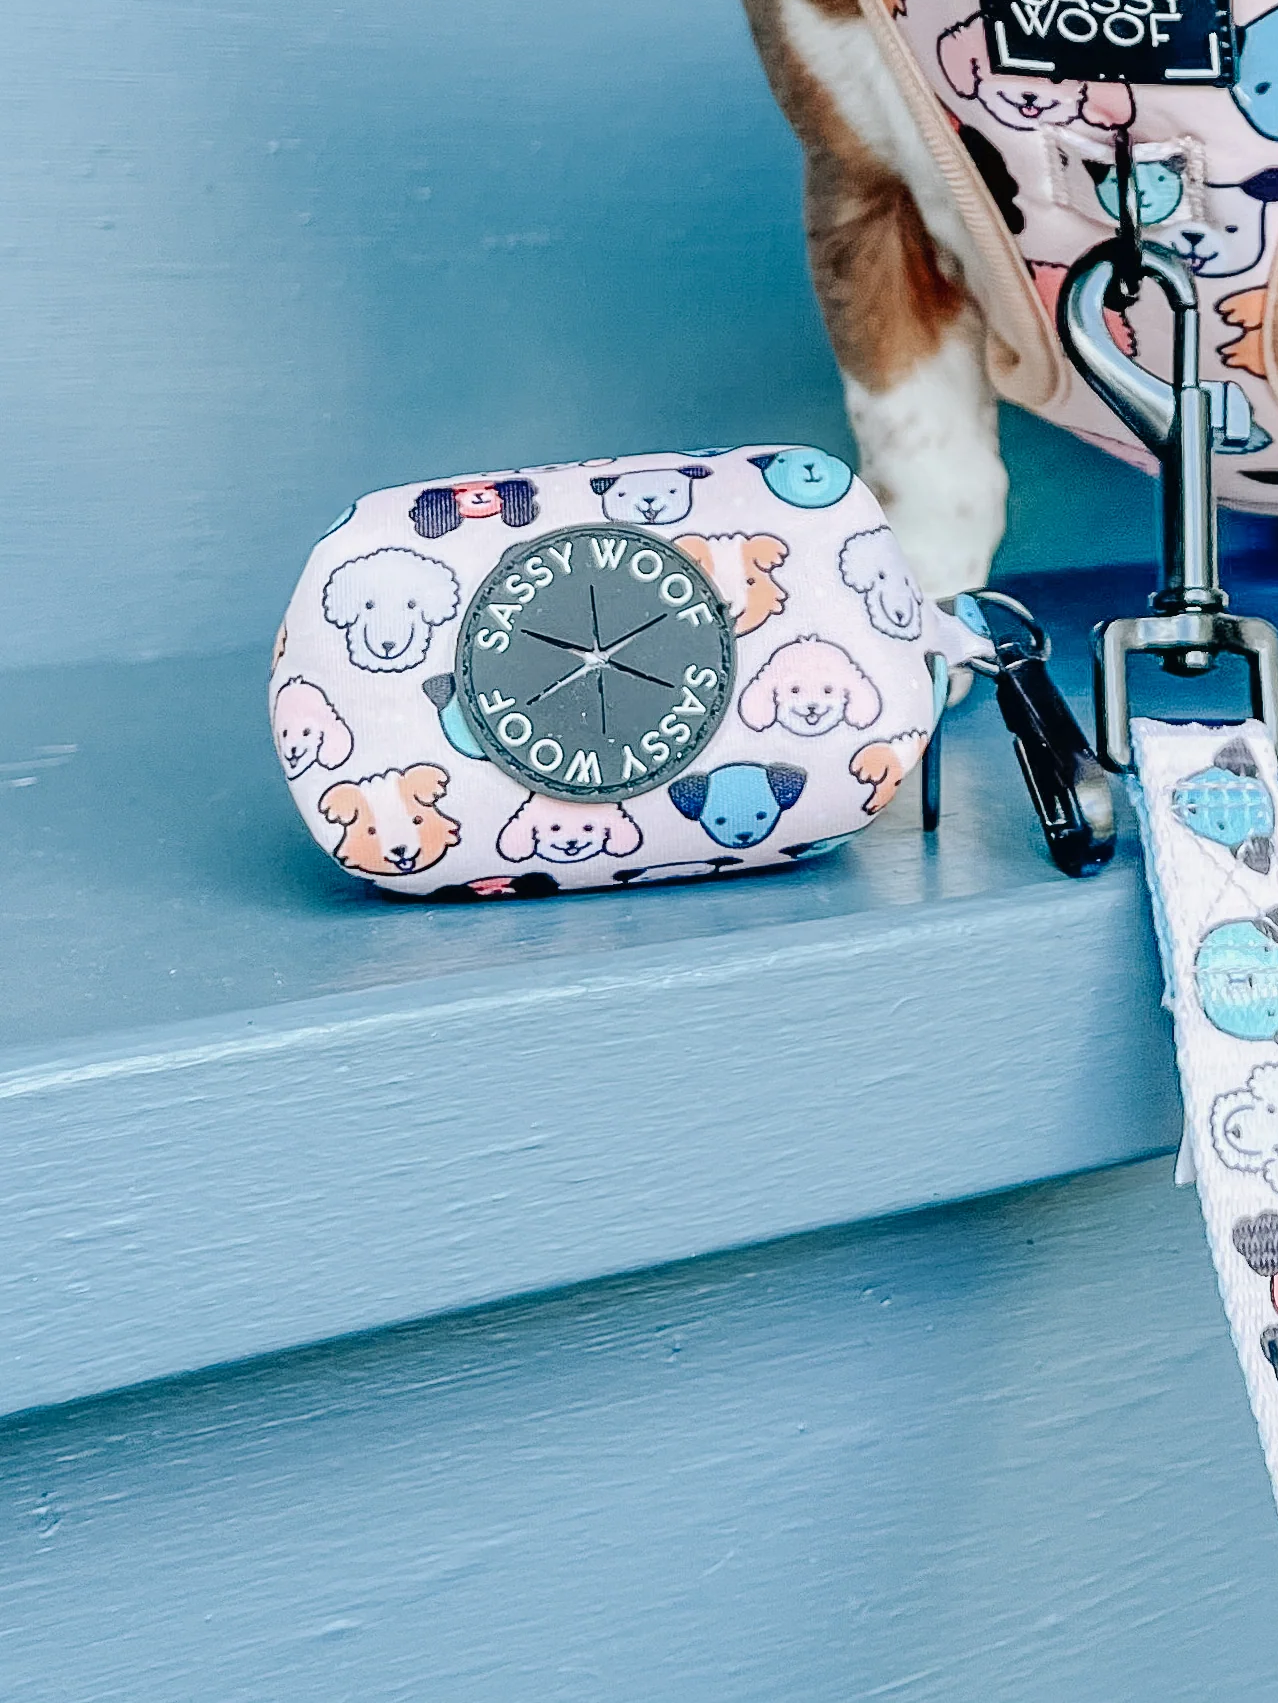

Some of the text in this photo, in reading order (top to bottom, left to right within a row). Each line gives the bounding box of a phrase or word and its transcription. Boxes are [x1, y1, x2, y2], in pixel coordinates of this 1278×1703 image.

[1011, 1, 1182, 47] WOOF
[477, 538, 714, 653] SASSY WOOF
[478, 664, 718, 784] SASSY WOOF
